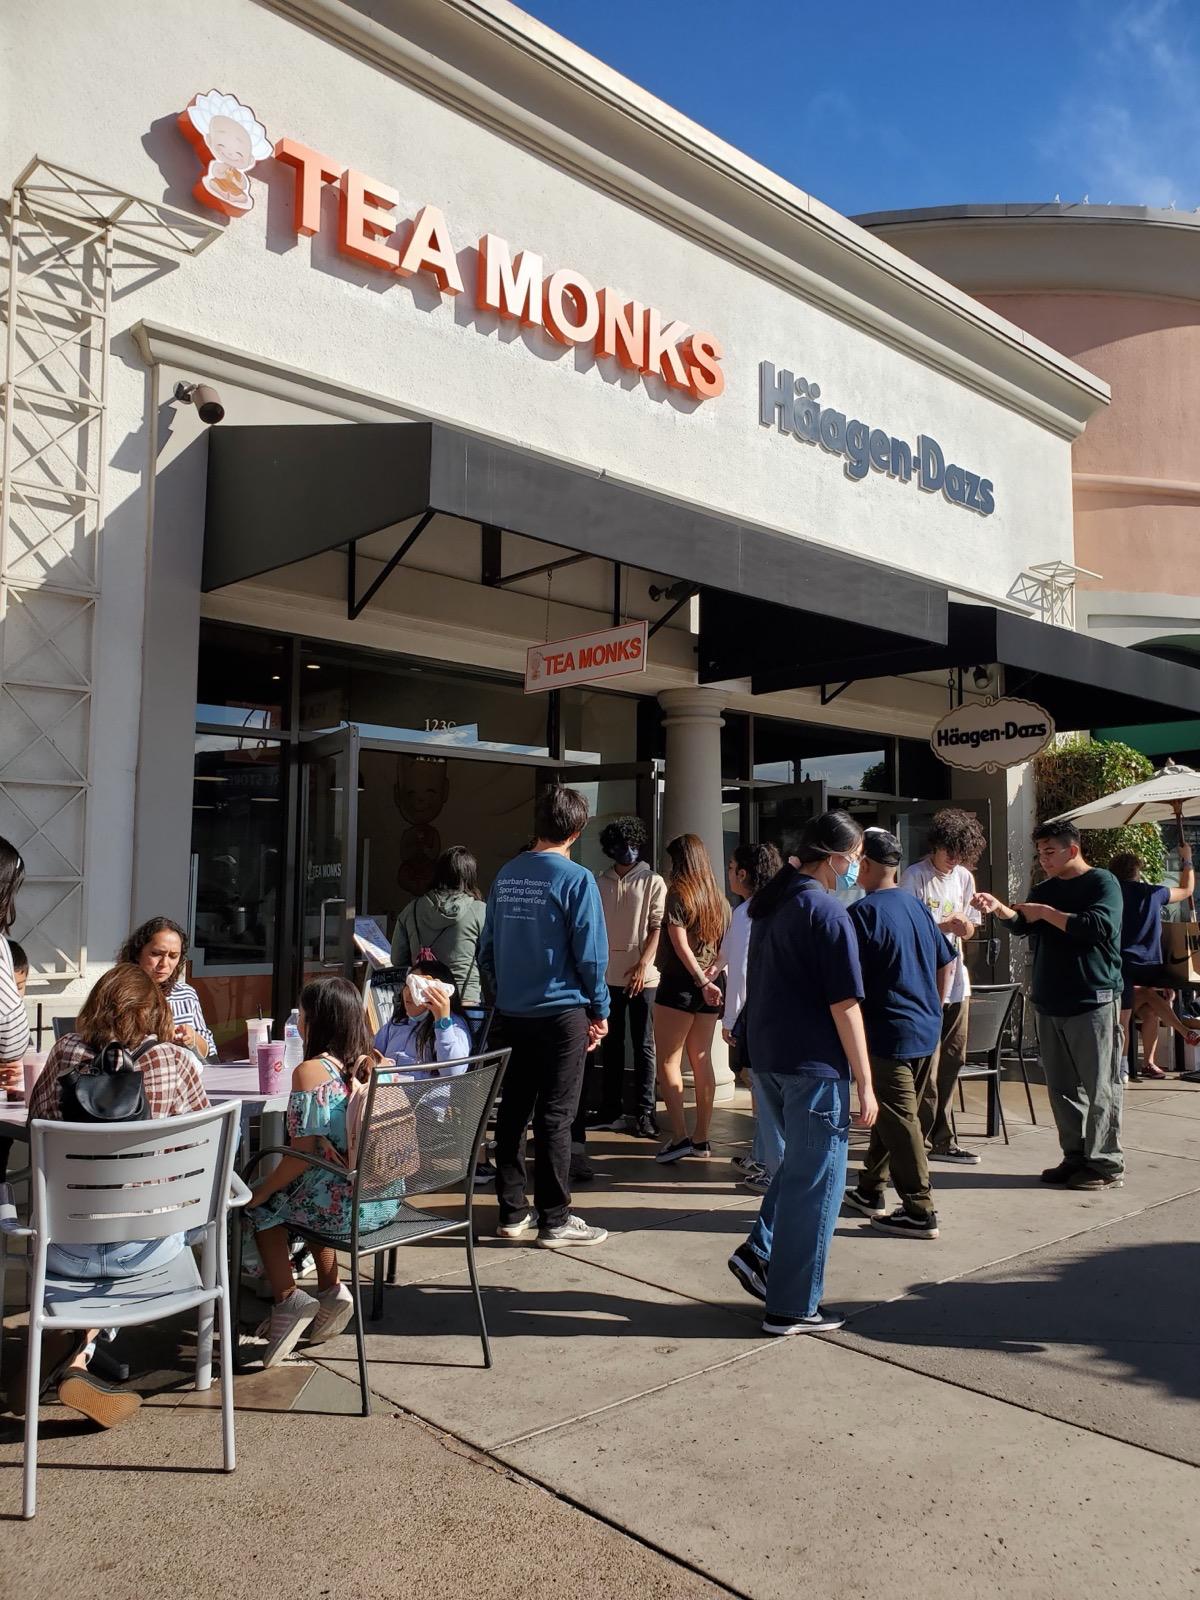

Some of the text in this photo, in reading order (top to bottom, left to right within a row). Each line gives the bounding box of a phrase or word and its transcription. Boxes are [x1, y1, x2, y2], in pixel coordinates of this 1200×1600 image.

[275, 138, 726, 401] TEA MONKS
[759, 360, 996, 518] Häagen-Dazs
[543, 637, 642, 676] TEA MONKS
[937, 721, 1047, 748] Häagen-Dazs
[499, 886, 543, 896] Sporting Goods
